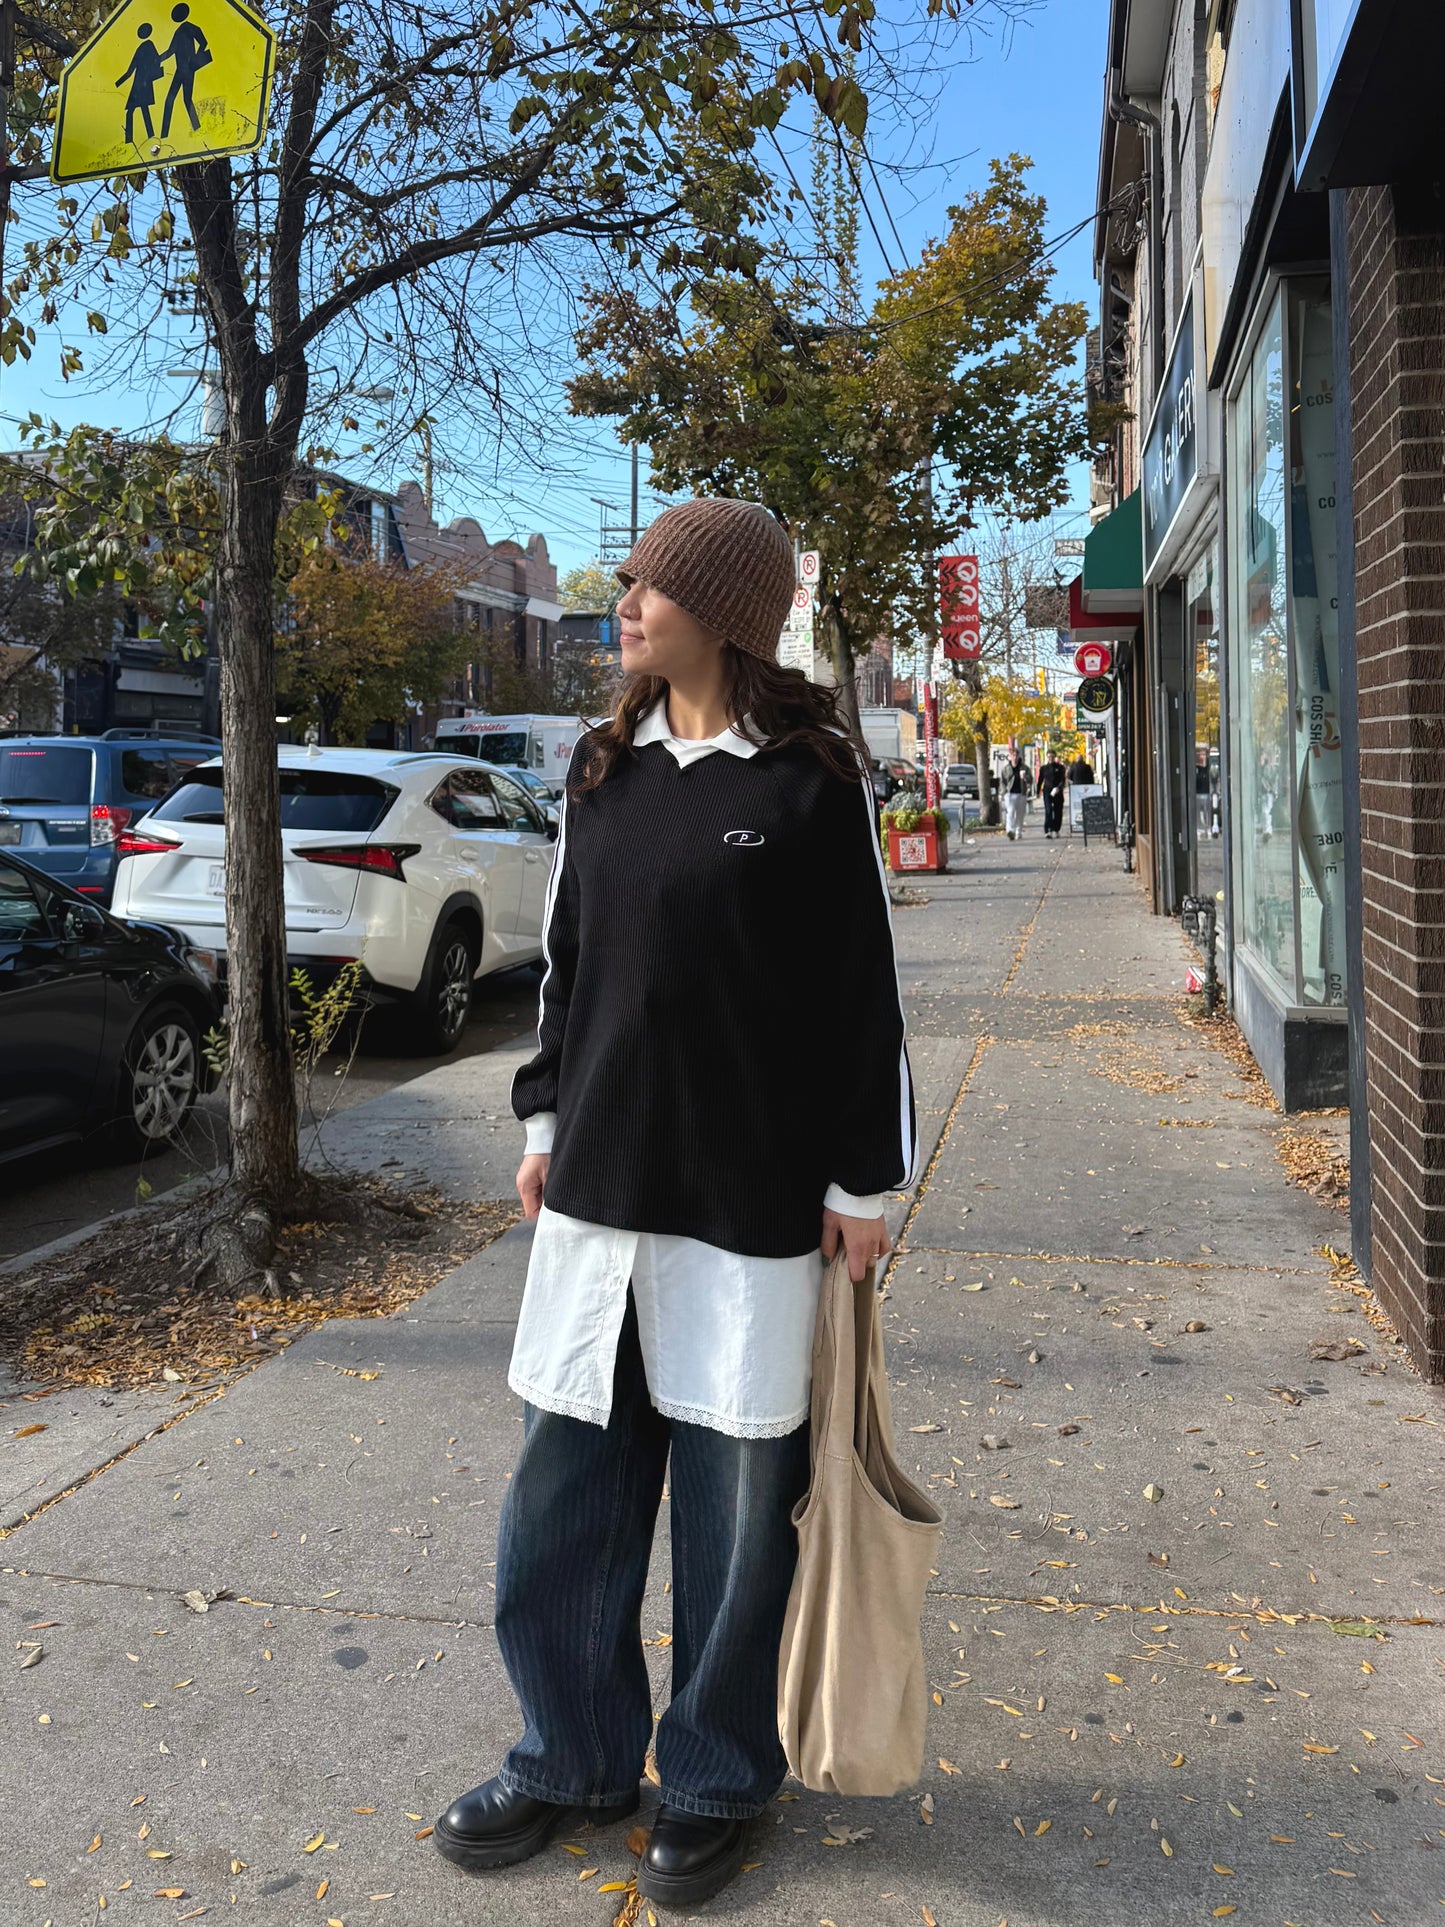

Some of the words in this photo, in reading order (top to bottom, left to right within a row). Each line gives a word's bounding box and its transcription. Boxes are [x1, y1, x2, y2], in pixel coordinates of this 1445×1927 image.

[1306, 392, 1333, 408] COS
[1318, 496, 1336, 510] CO
[950, 614, 978, 622] ueen
[1318, 832, 1344, 846] ORE
